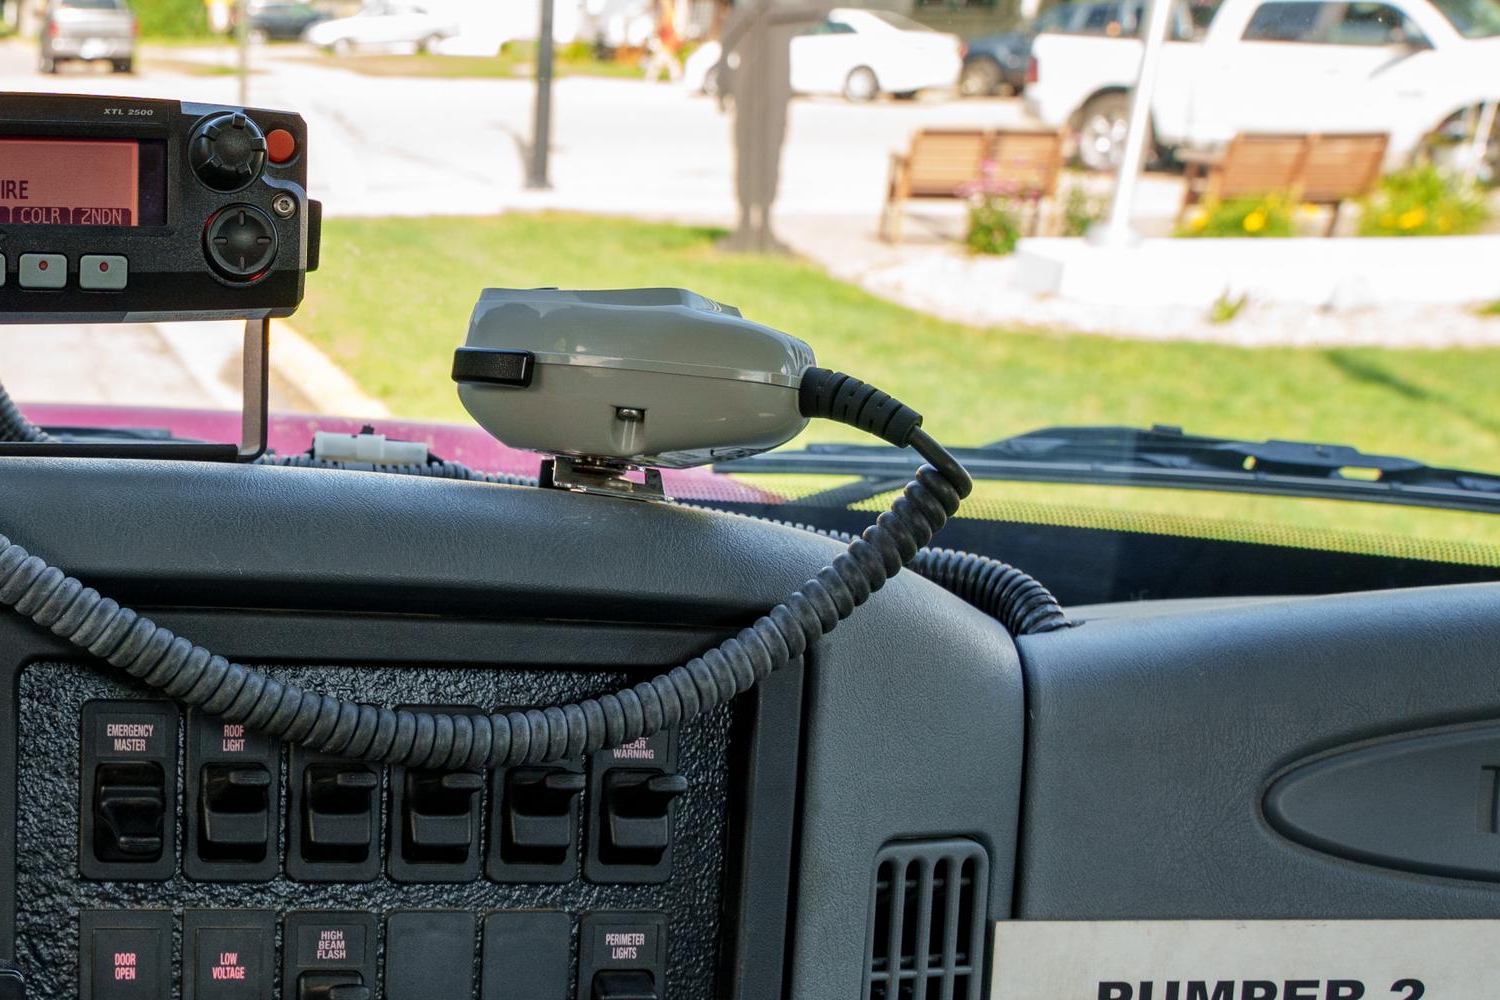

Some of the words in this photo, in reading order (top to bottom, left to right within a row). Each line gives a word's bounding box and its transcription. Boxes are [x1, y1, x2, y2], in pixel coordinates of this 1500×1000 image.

[103, 108, 125, 116] XTL
[20, 207, 60, 224] COLR
[81, 208, 122, 225] ZNDN
[107, 724, 154, 737] EMERGENCY
[223, 724, 245, 737] ROOF
[114, 738, 146, 752] MASTER
[222, 738, 245, 752] LIGHT
[613, 749, 655, 759] WARNING
[321, 930, 344, 940] HIGH
[605, 933, 645, 946] PERIMETER
[318, 940, 345, 950] BEAM
[220, 952, 238, 966] LOW
[317, 949, 346, 960] FLASH
[612, 946, 637, 959] LIGHTS
[114, 953, 136, 966] DOOR
[114, 967, 136, 980] OPEN
[212, 966, 245, 980] VOLTAGE
